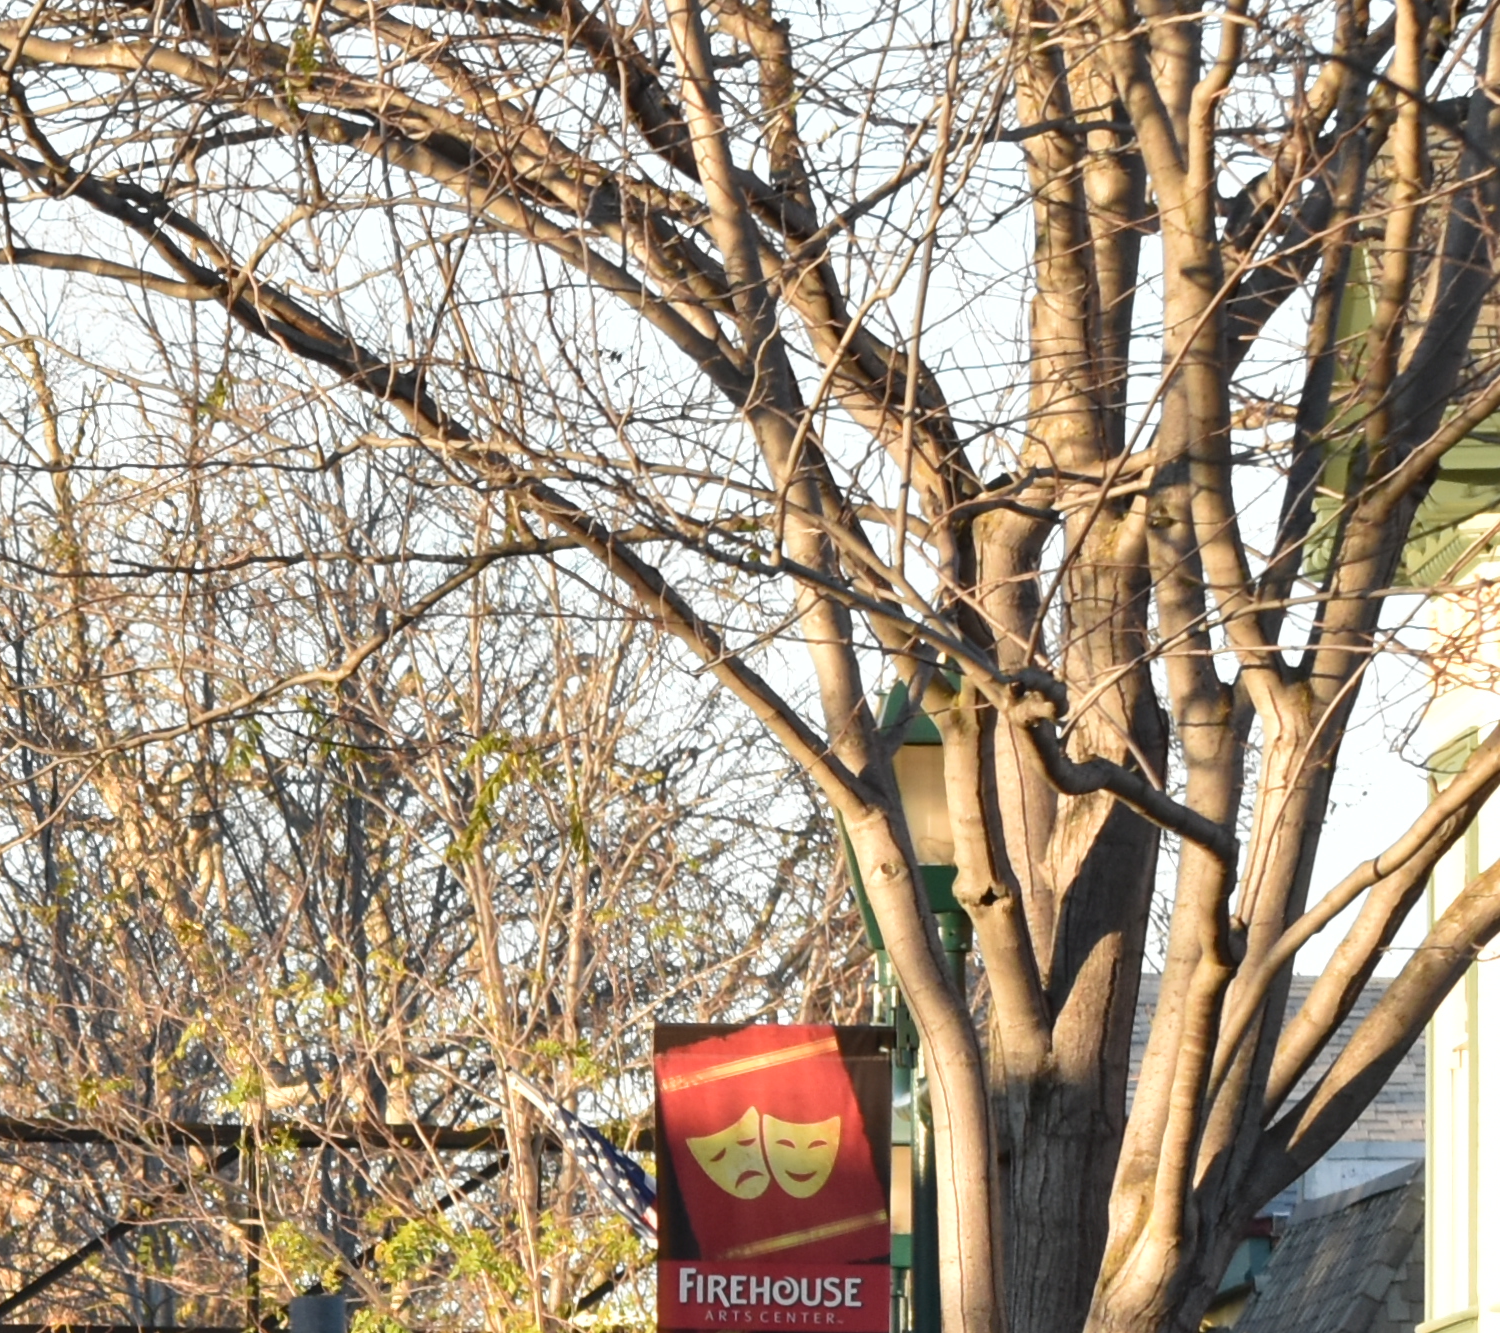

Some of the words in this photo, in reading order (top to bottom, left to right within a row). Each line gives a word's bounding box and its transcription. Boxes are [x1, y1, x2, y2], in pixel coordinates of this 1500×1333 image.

[679, 1267, 862, 1308] FIREHOUSE
[705, 1310, 752, 1322] ARTS
[760, 1311, 836, 1324] CENTER
